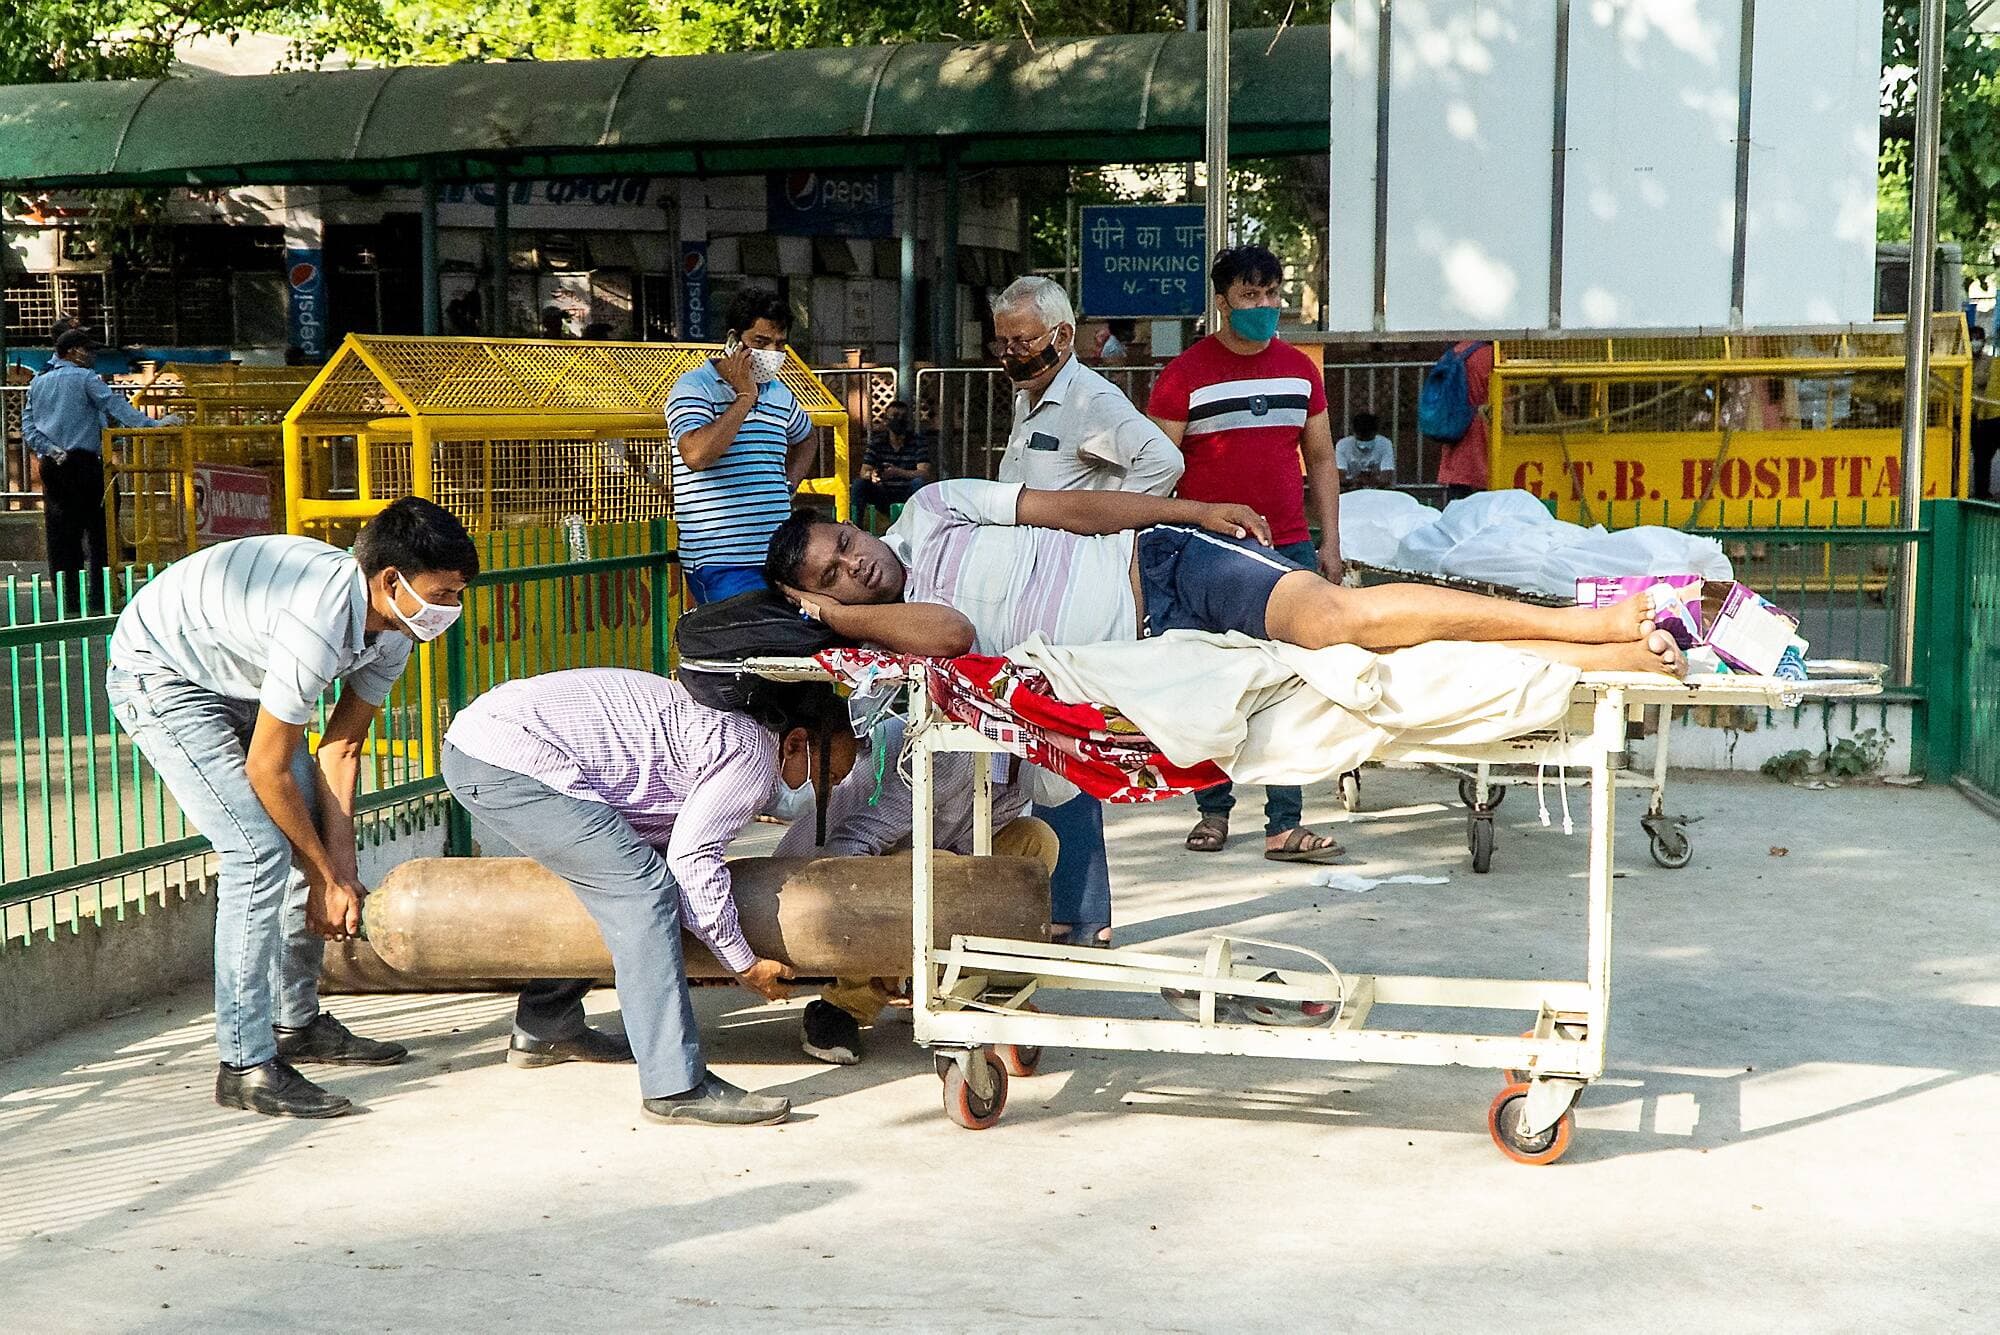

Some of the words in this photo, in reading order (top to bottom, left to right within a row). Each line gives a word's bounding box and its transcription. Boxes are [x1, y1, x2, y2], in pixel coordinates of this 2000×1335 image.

[822, 174, 879, 209] pepsi
[1090, 217, 1125, 249] पीने
[1136, 226, 1162, 248] का
[1104, 255, 1200, 273] DRINKING
[293, 294, 321, 355] pepsi
[686, 281, 705, 338] pepsi
[1513, 459, 1661, 501] G.T.B.
[1680, 456, 1937, 500] HOSPITA
